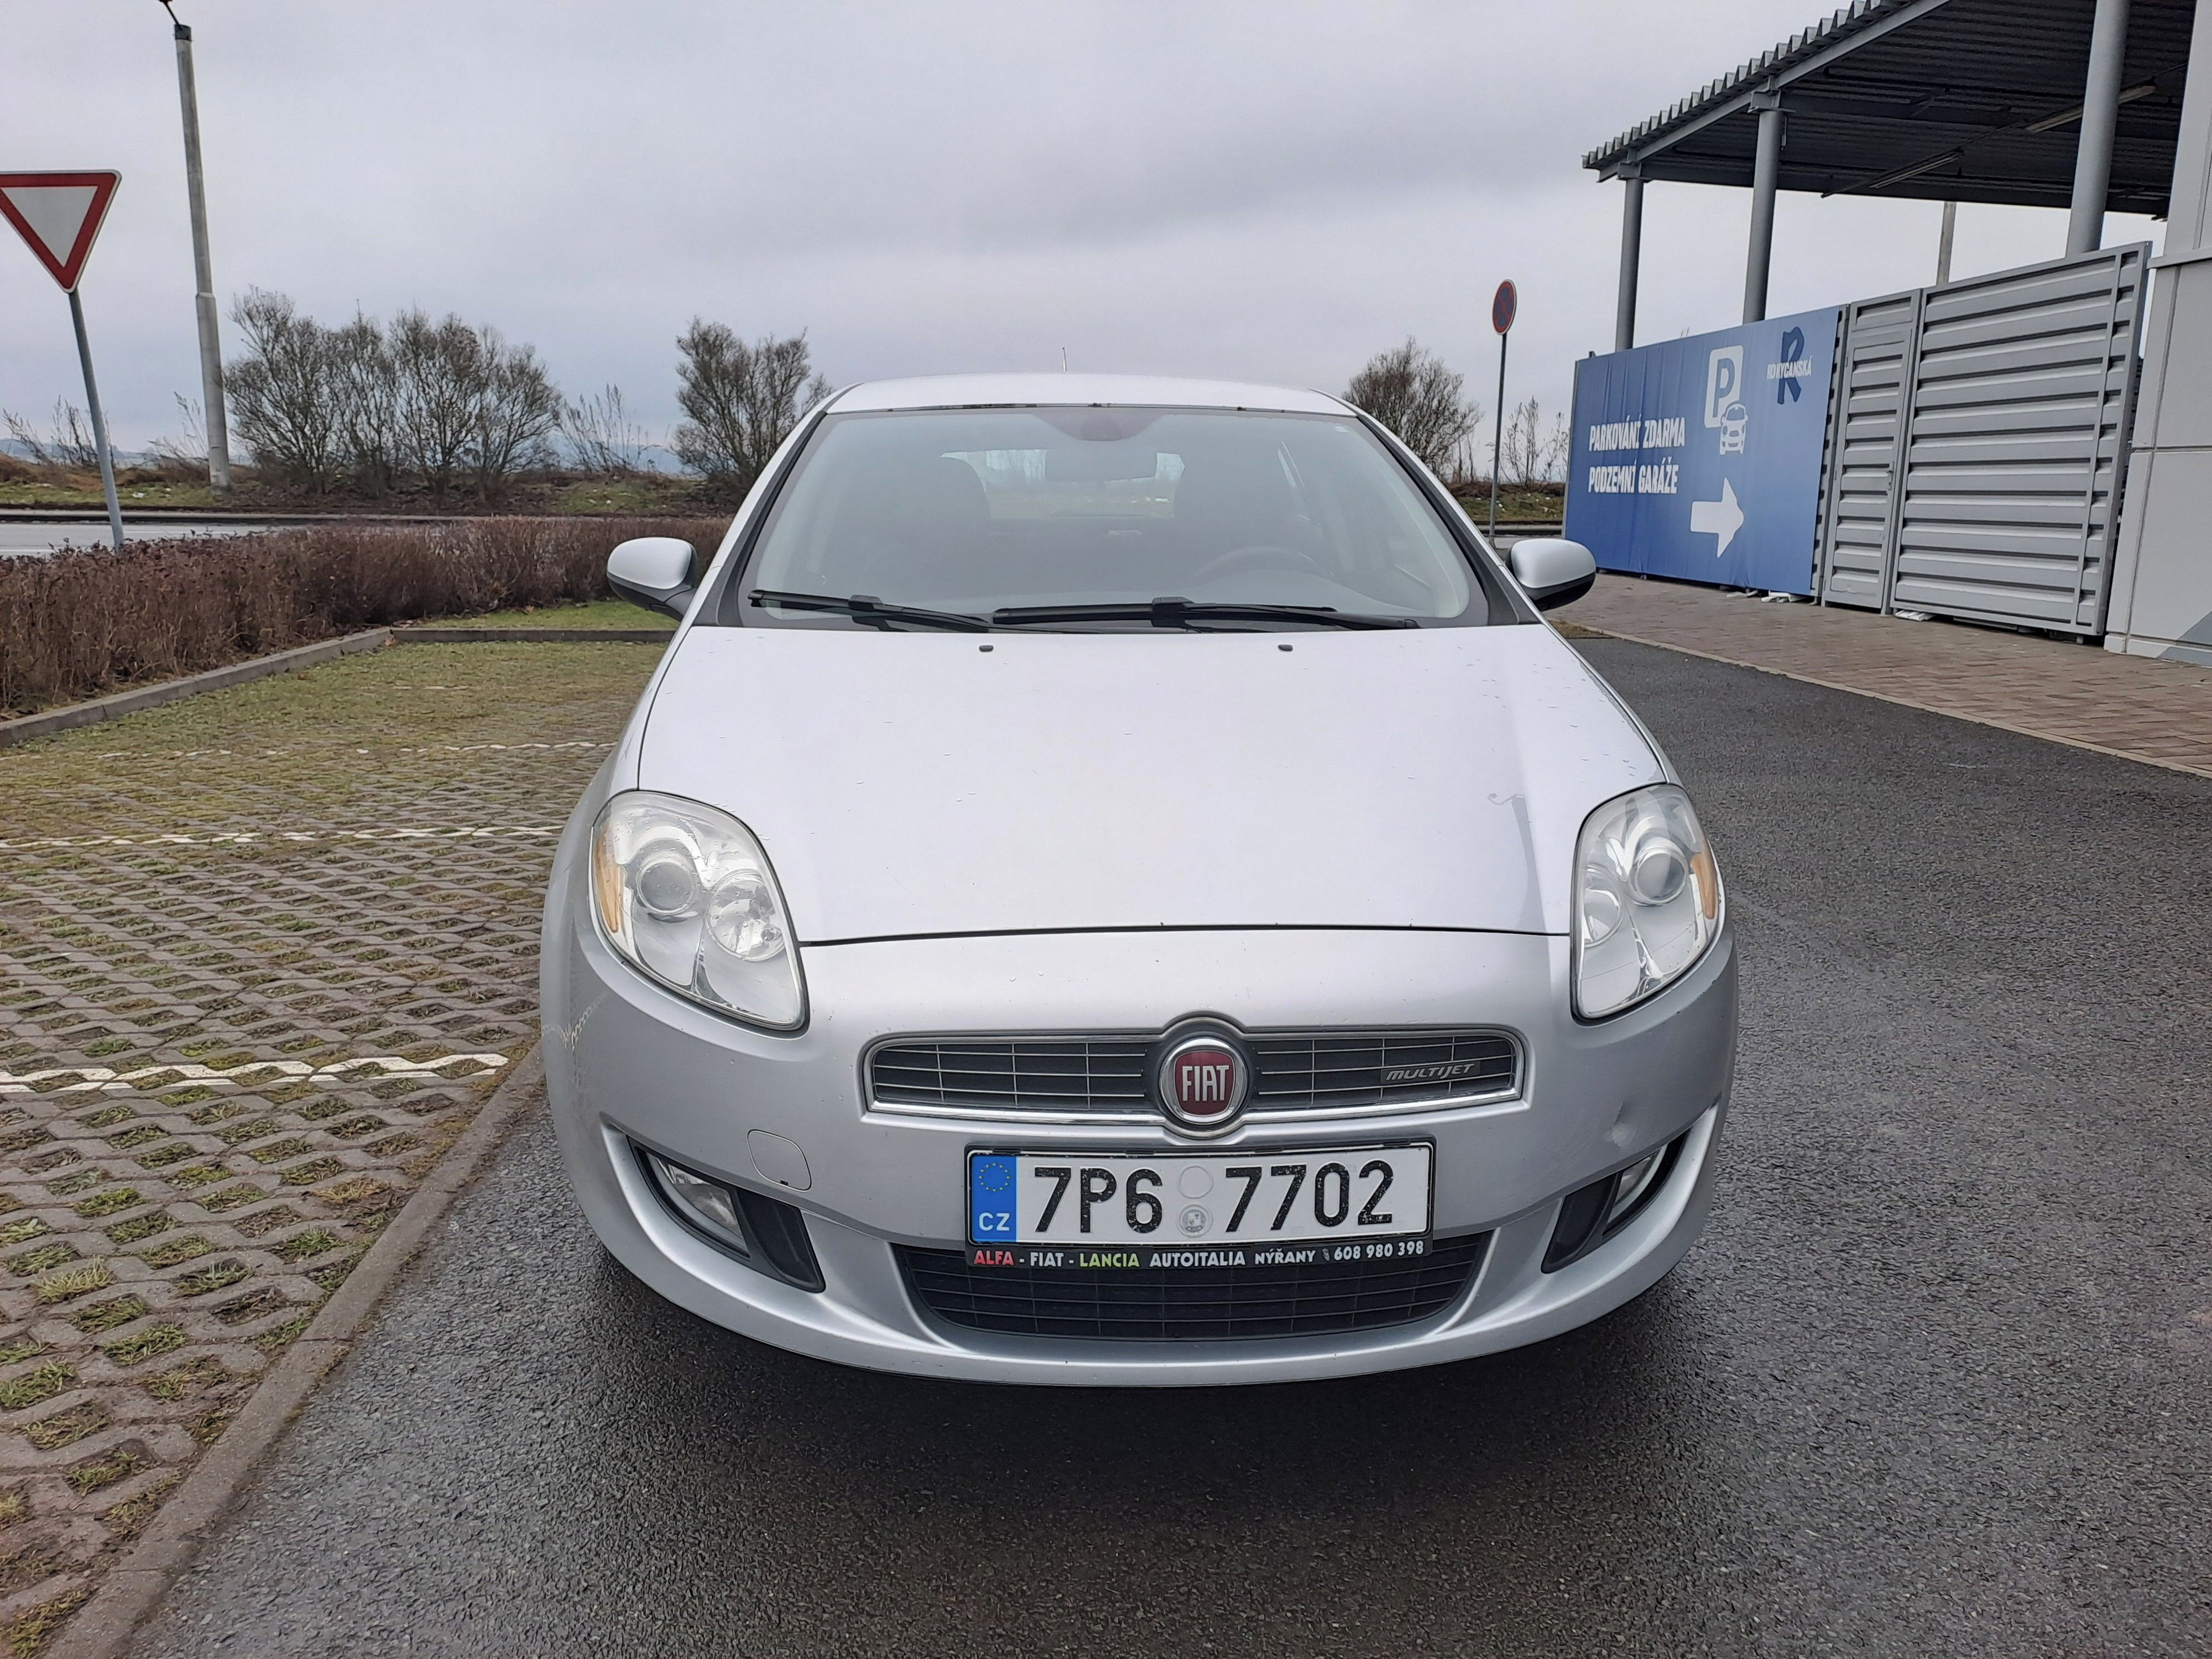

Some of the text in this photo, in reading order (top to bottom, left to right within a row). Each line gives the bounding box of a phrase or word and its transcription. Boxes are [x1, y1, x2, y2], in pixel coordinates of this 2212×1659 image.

[1589, 414, 1685, 451] PARKOVÁNÍ ZDARMA
[1588, 456, 1679, 494] PODZEMNÍ GARÁŽE
[1182, 1065, 1230, 1102] FIAT
[1385, 1063, 1475, 1082] MULTIJET
[1034, 1160, 1394, 1234] 7P6 7702
[978, 1213, 1010, 1232] CZ
[974, 1250, 1015, 1266] ALFA
[1030, 1252, 1065, 1267] FIAT
[1080, 1254, 1140, 1267] LANCIA
[1149, 1251, 1246, 1267] AUTOITALIA
[1255, 1248, 1316, 1265] NÝŘANY
[1334, 1246, 1361, 1261] 608
[1366, 1243, 1393, 1259] 980
[1397, 1240, 1424, 1256] 398
